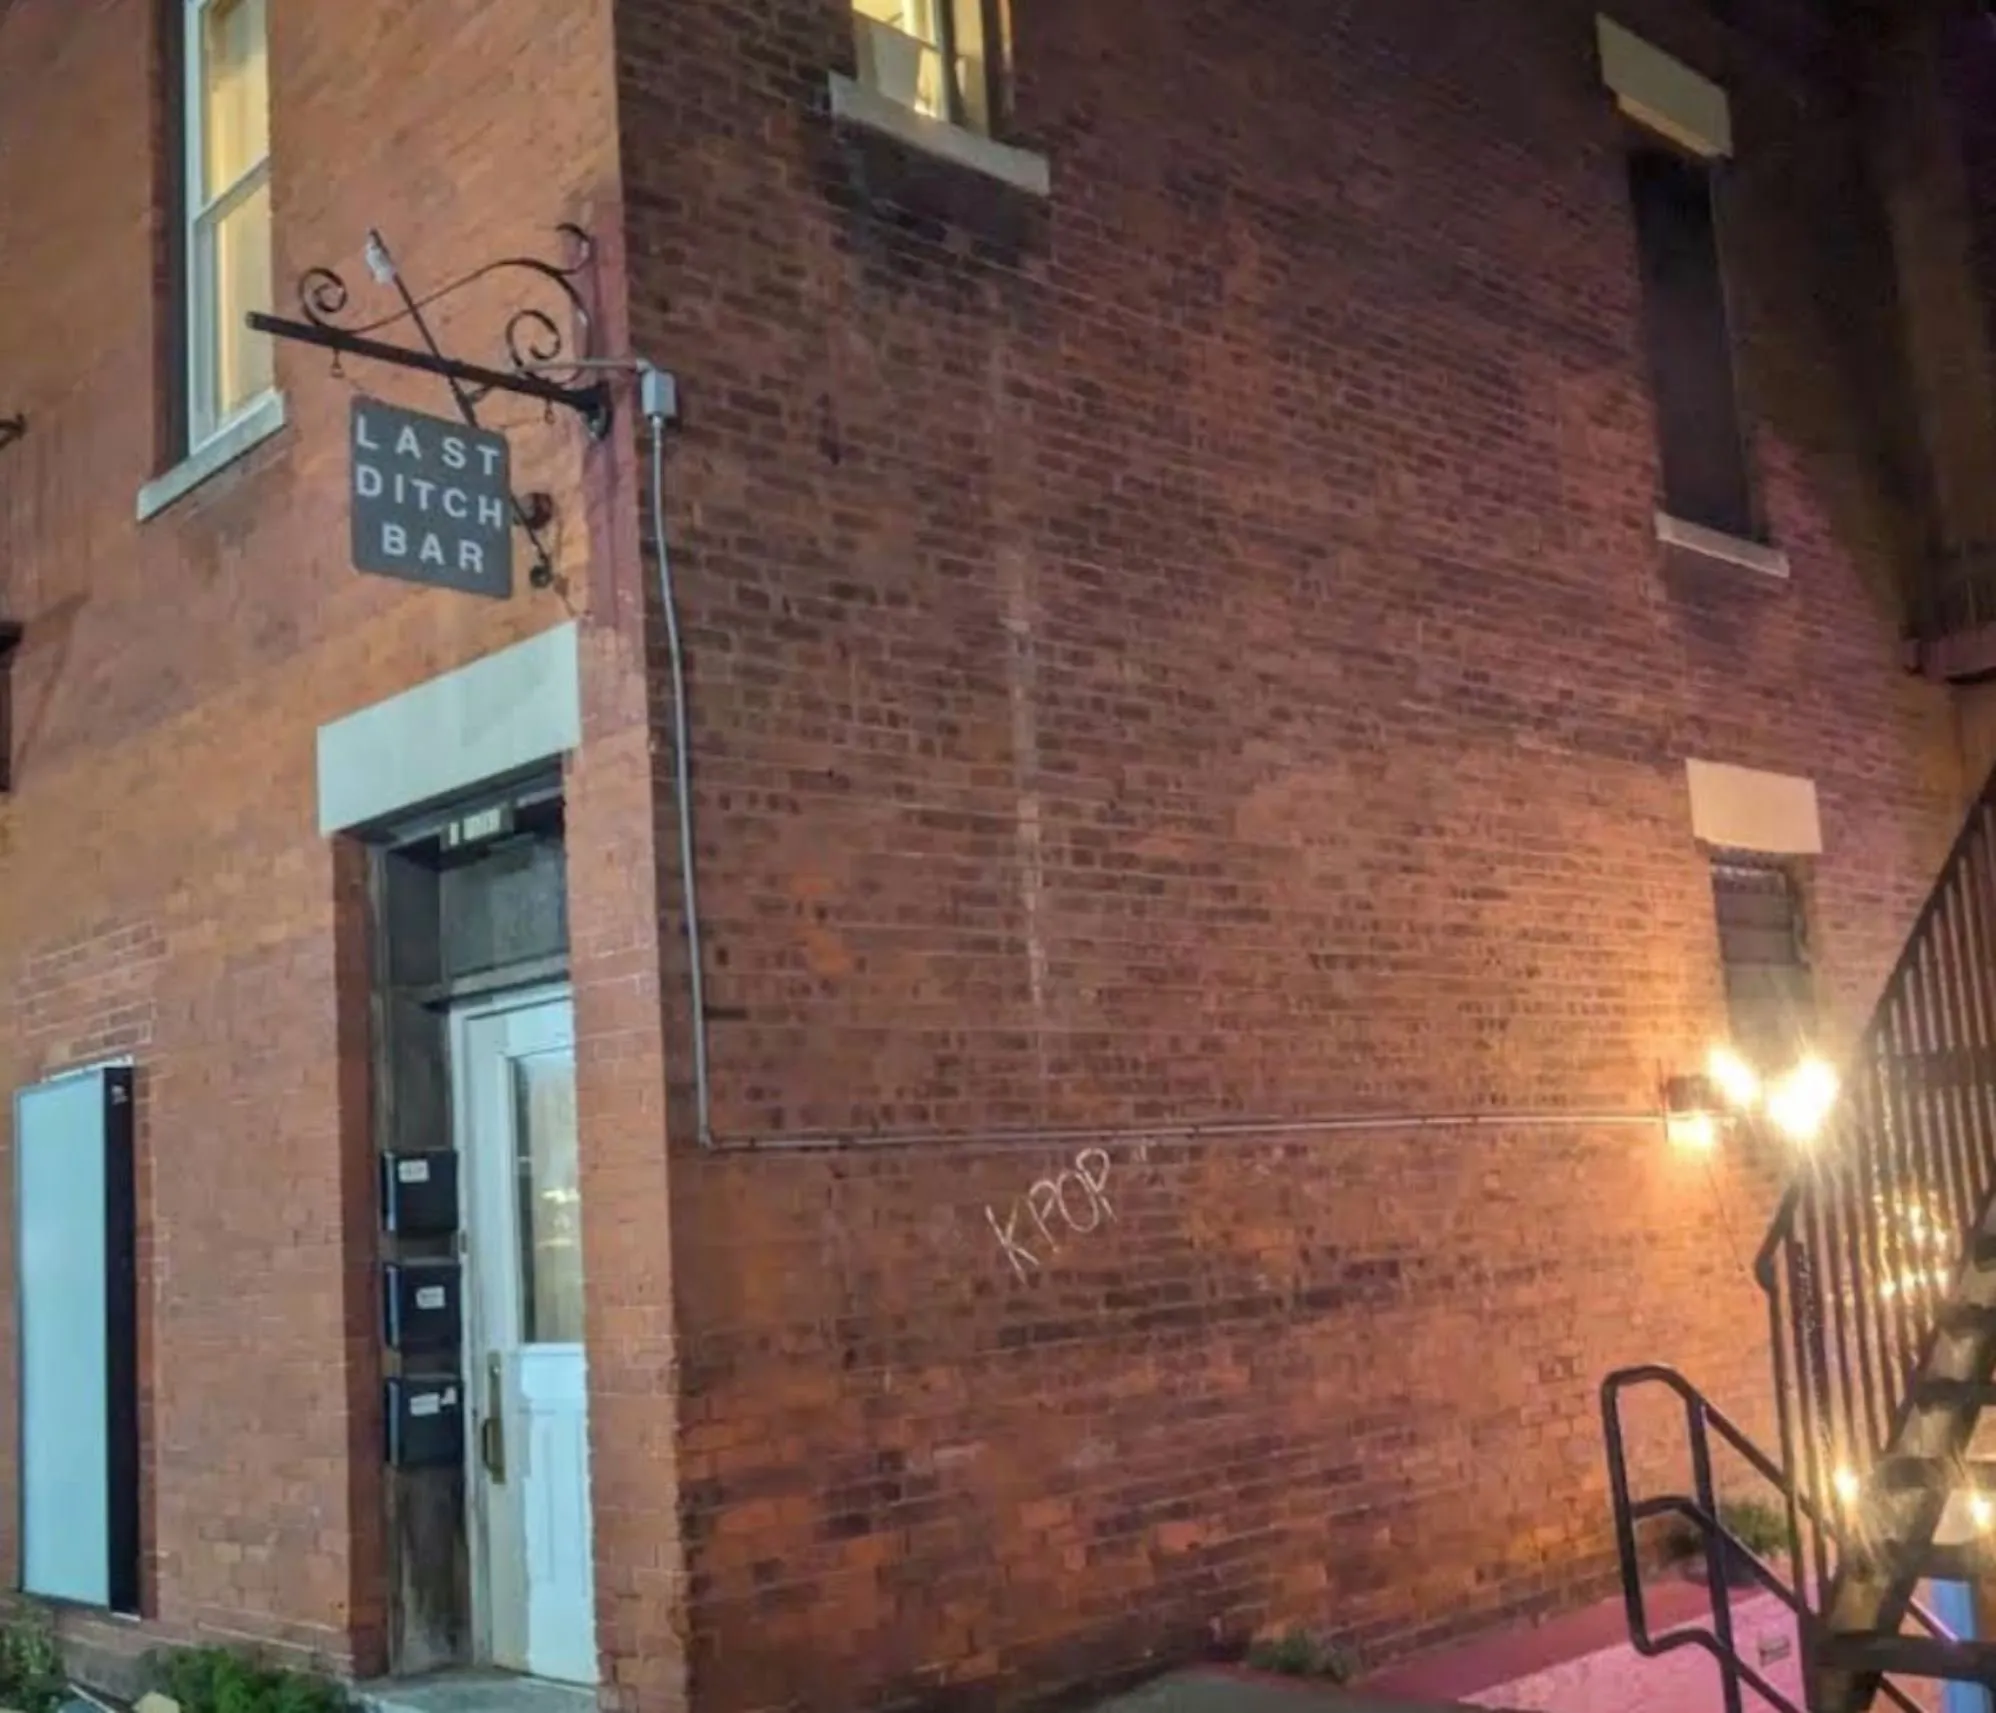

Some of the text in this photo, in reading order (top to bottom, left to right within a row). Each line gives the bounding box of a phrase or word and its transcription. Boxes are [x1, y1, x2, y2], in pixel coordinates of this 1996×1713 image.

[356, 413, 500, 476] LAST
[356, 463, 503, 530] DITCH
[381, 522, 484, 574] BAR
